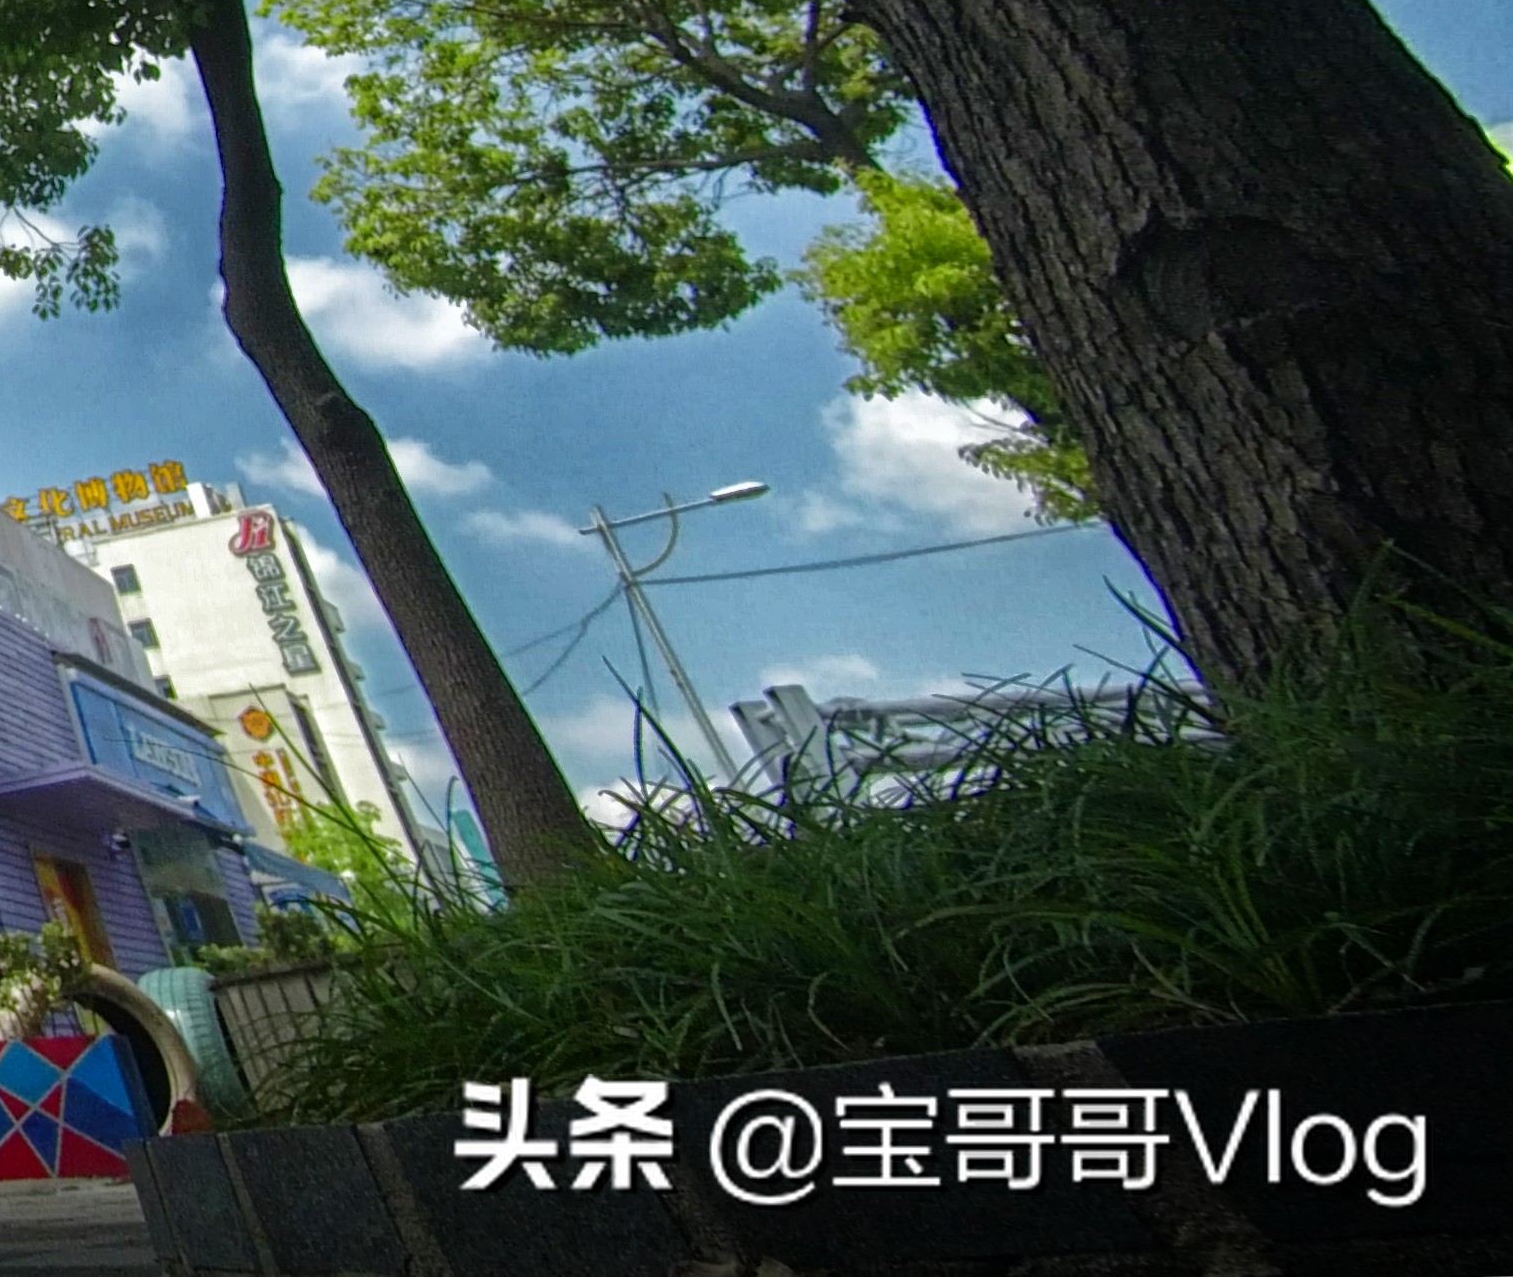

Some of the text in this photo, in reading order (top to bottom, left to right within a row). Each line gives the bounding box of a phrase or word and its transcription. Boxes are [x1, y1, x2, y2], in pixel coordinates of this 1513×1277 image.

[1, 460, 188, 523] 文化博物馆
[247, 553, 321, 676] 锦江之星
